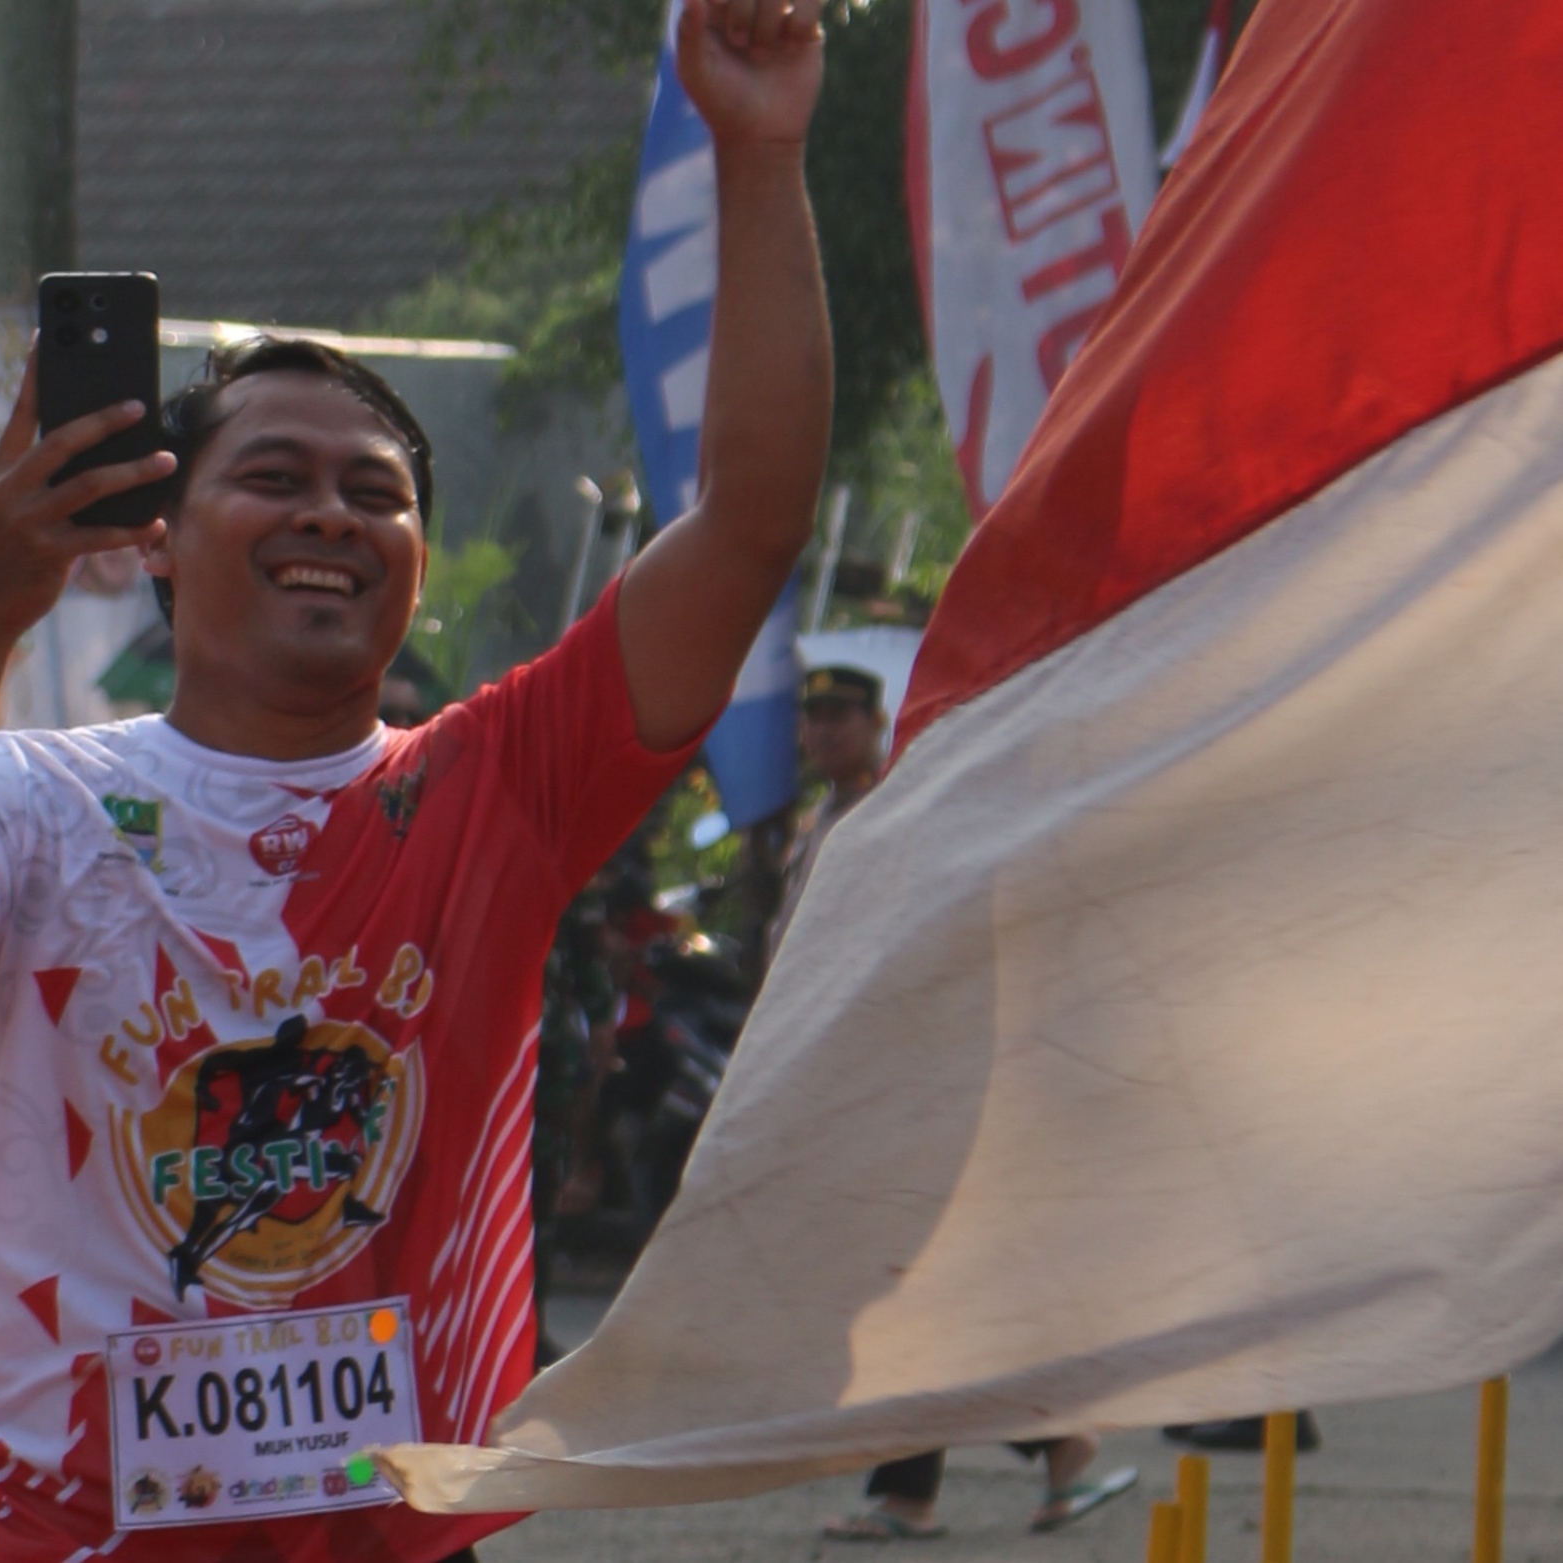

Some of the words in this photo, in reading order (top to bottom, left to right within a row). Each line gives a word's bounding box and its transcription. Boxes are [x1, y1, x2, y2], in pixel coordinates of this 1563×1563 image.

[261, 828, 308, 854] RW
[98, 974, 206, 1086] FUN
[169, 1335, 224, 1362] FUN
[236, 1323, 304, 1354] TRAIL
[314, 1314, 360, 1347] 8.0
[133, 1350, 396, 1441] K.081104
[253, 1437, 293, 1457] MUH
[295, 1431, 350, 1452] YUSUF
